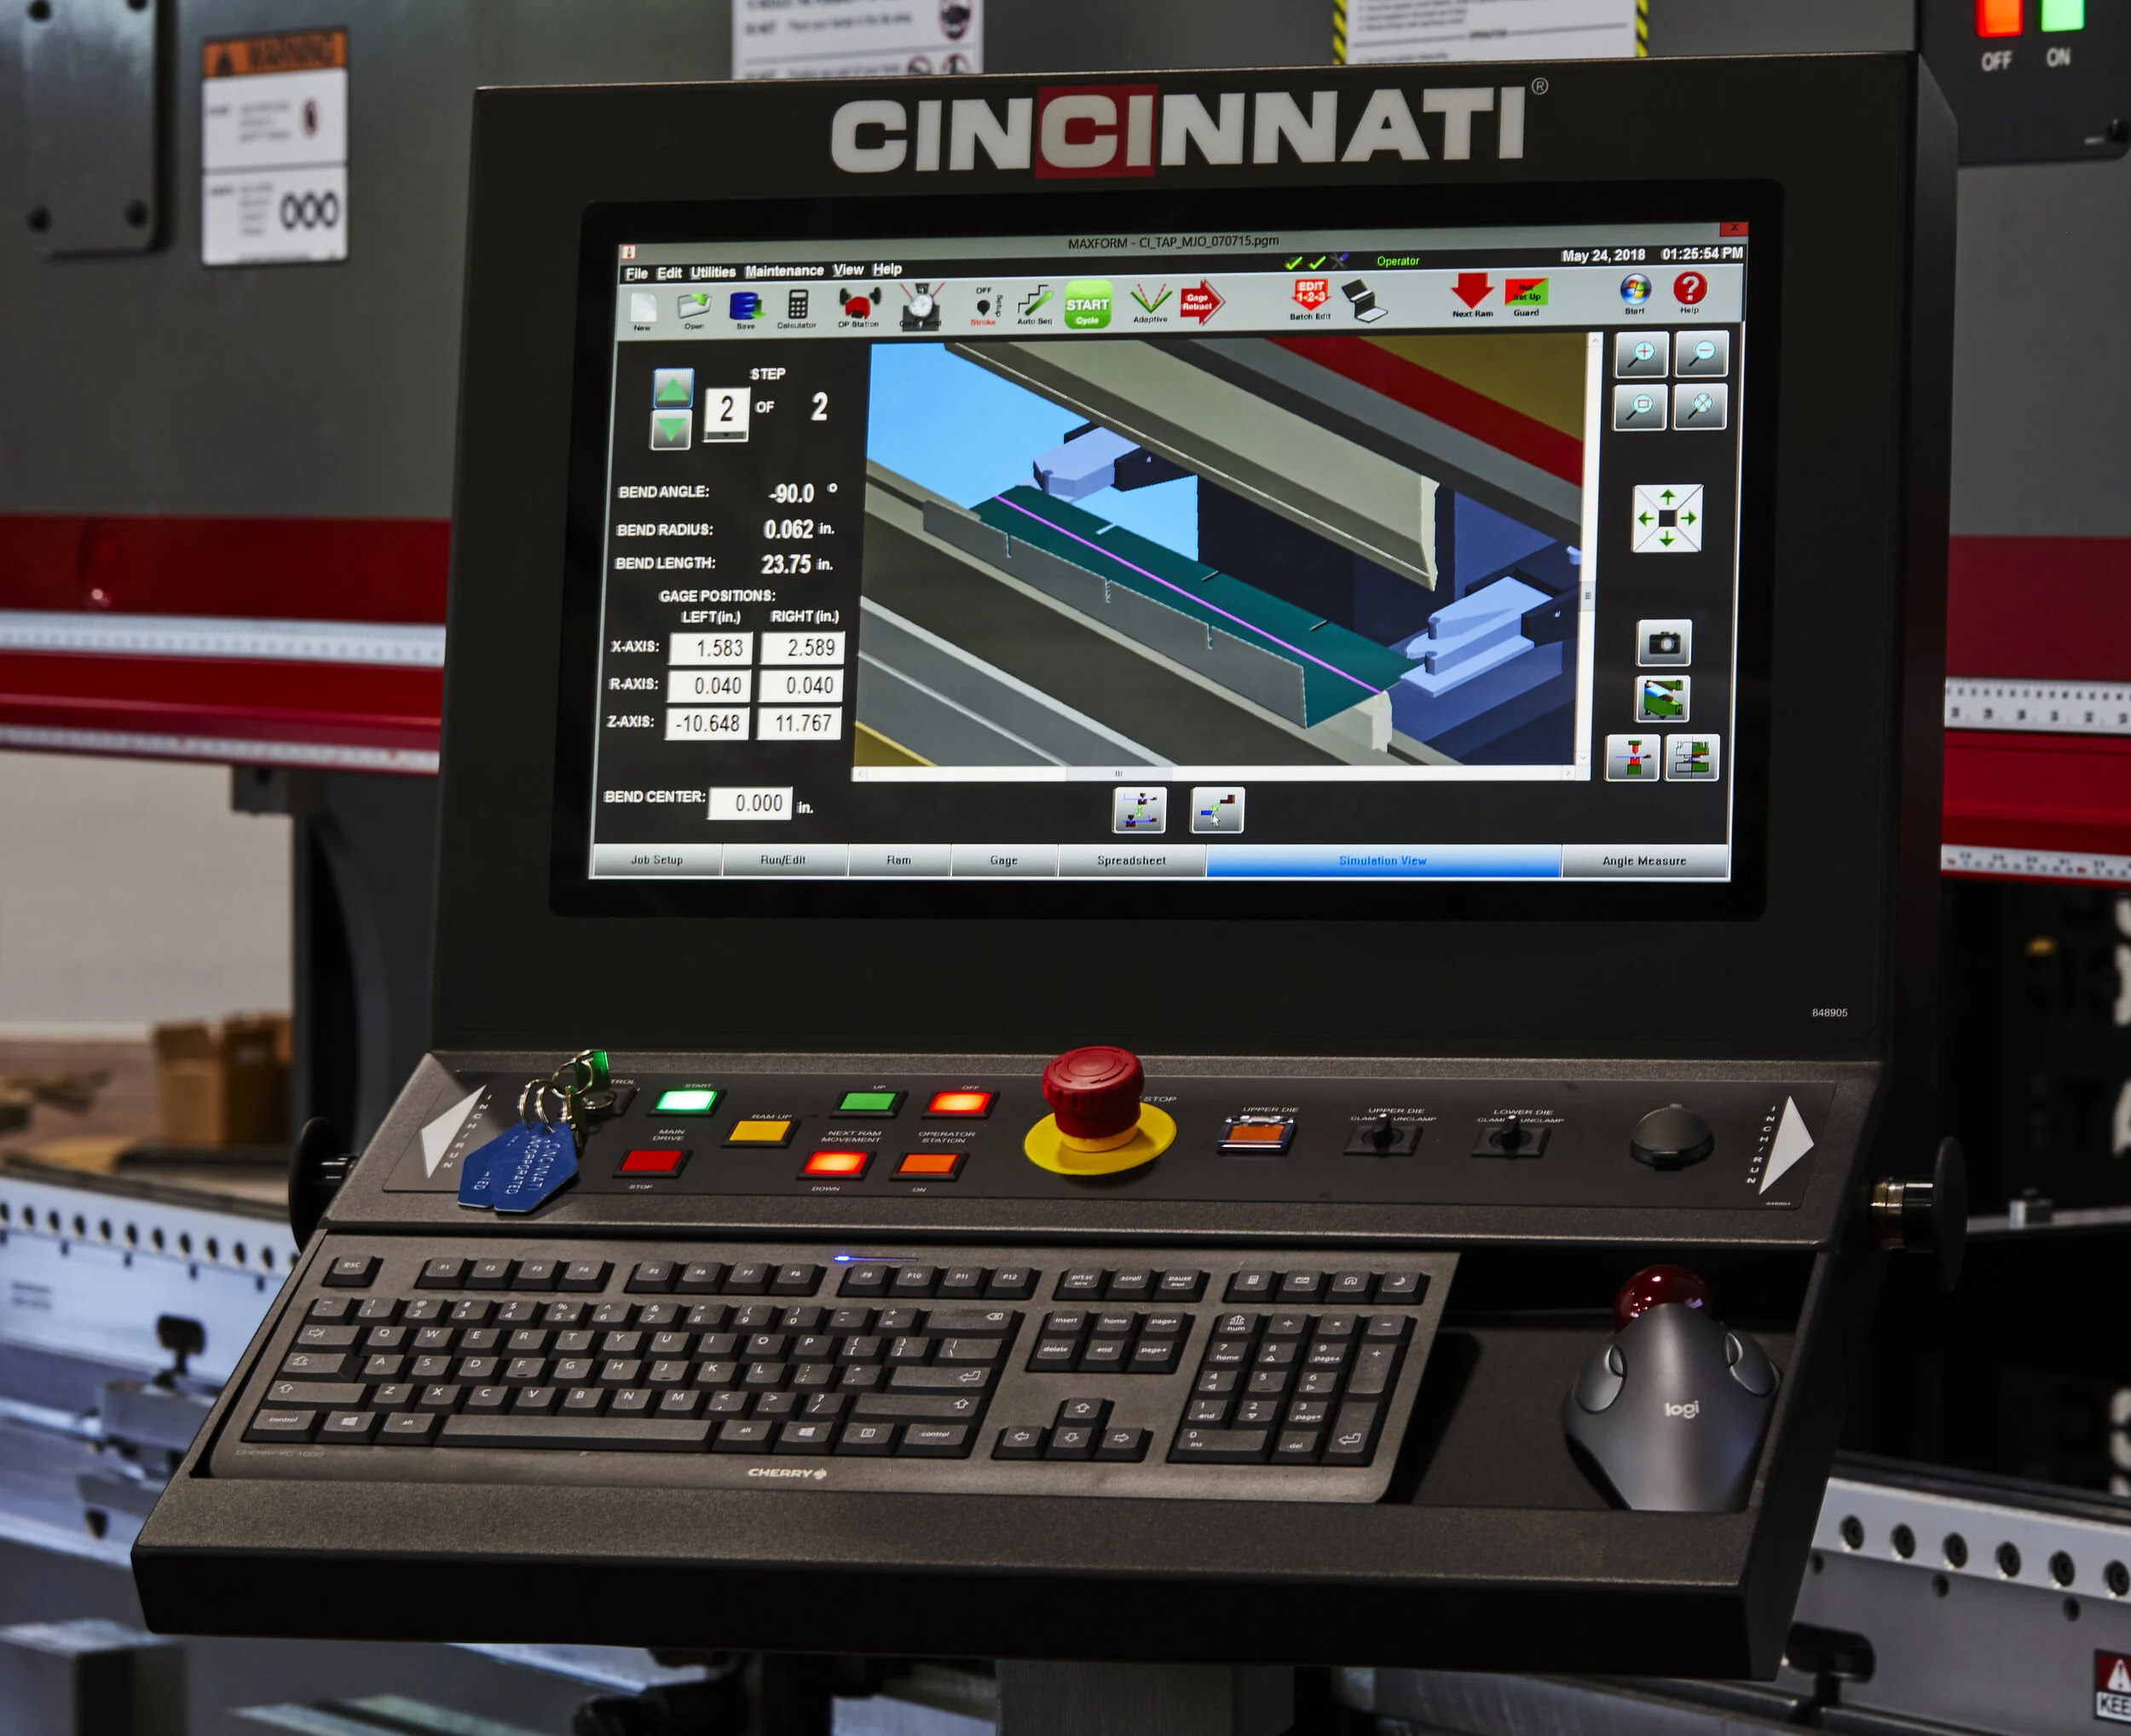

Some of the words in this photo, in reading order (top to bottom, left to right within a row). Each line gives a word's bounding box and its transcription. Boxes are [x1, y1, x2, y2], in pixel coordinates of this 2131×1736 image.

[1981, 49, 2013, 72] OFF
[2046, 47, 2071, 67] ON
[831, 86, 1525, 173] CINCINNATI
[1068, 238, 1128, 250] MAXFORM
[1139, 234, 1279, 251] CI_TAP_MJO_070715.pgm
[1562, 250, 1588, 264] May
[1591, 249, 1612, 262] 24,
[1614, 248, 1646, 261] 2018
[1661, 247, 1719, 260] 01:25:54
[1723, 245, 1743, 259] PM
[1377, 256, 1419, 268] Operator
[625, 267, 648, 280] File
[655, 266, 683, 280] Edit
[690, 265, 736, 280] Utilities
[744, 264, 824, 279] Maintenance
[832, 263, 864, 278] View
[872, 262, 903, 277] Help
[1297, 281, 1325, 291] EDIT
[1186, 293, 1208, 303] Gage
[1296, 291, 1325, 303] 1-2-3
[1529, 292, 1541, 301] Up
[1066, 298, 1109, 311] START
[1625, 307, 1645, 315] Start
[1680, 306, 1699, 315] Help
[684, 323, 704, 332] Open
[852, 320, 880, 328] Station
[1074, 316, 1100, 326] Cycle
[749, 367, 786, 380] STEP
[719, 395, 734, 422] 2
[754, 401, 775, 413] OF
[811, 391, 829, 421] 2
[618, 486, 657, 498] BEND
[659, 485, 710, 498] ANGLE:
[768, 483, 814, 503] -90.0
[615, 524, 655, 536] BEND
[656, 523, 713, 536] RADIUS:
[763, 519, 814, 539] 0.062
[817, 522, 834, 535] in.
[615, 557, 654, 569] BEND
[655, 557, 716, 569] LENGTH:
[760, 555, 811, 574] 23.75
[816, 558, 834, 570] in.
[658, 590, 697, 603] GAGE
[699, 590, 777, 602] POSITIONS:
[610, 640, 660, 653] X-AXIS:
[696, 638, 743, 657] 1.583
[788, 638, 836, 657] 2.589
[609, 678, 659, 690] R-AXIS:
[695, 677, 742, 695] 0.040
[786, 676, 834, 695] 0.040
[607, 715, 655, 728] Z-AXIS:
[676, 714, 740, 733] -10.648
[776, 714, 833, 732] 11.767
[603, 791, 644, 803] BEND
[646, 790, 707, 803] CENTER:
[735, 793, 783, 812] 0.000
[795, 801, 814, 814] in.
[631, 854, 650, 866] Job
[652, 854, 684, 868] Setup
[759, 853, 806, 867] Run/Edit
[886, 854, 911, 866] Ram
[990, 854, 1018, 868] Gage
[1096, 853, 1167, 868] Spreadsheet
[1338, 854, 1396, 867] Simulation
[1400, 854, 1428, 867] View
[1602, 854, 1633, 868] Angle
[1637, 854, 1687, 867] Measure
[1811, 1007, 1848, 1018] 848905
[1664, 1400, 1700, 1419] logi
[748, 1468, 814, 1479] CHERRY
[2100, 1694, 2131, 1716] KEE
